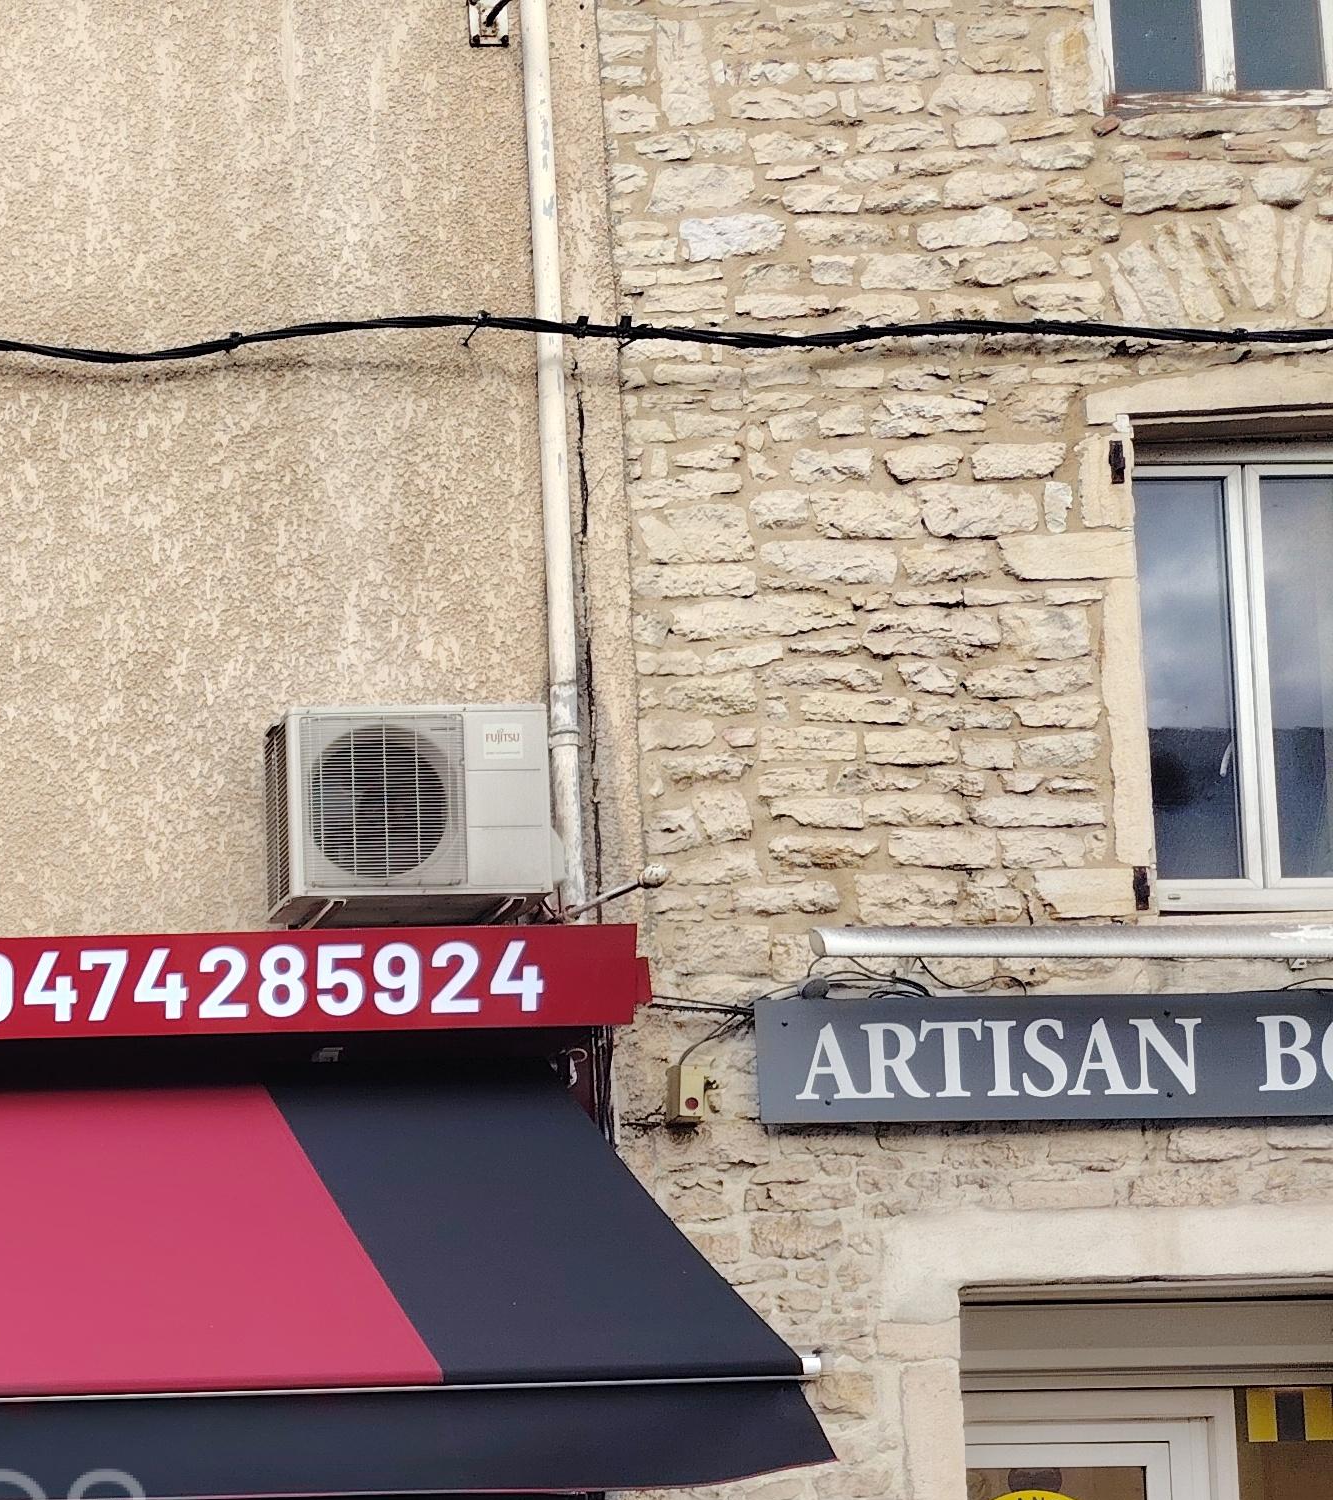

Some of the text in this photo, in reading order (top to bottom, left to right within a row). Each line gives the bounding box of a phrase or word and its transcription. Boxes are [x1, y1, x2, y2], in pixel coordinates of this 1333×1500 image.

[485, 728, 520, 743] FUJITSU
[795, 1015, 1333, 1101] ARTISAN B
